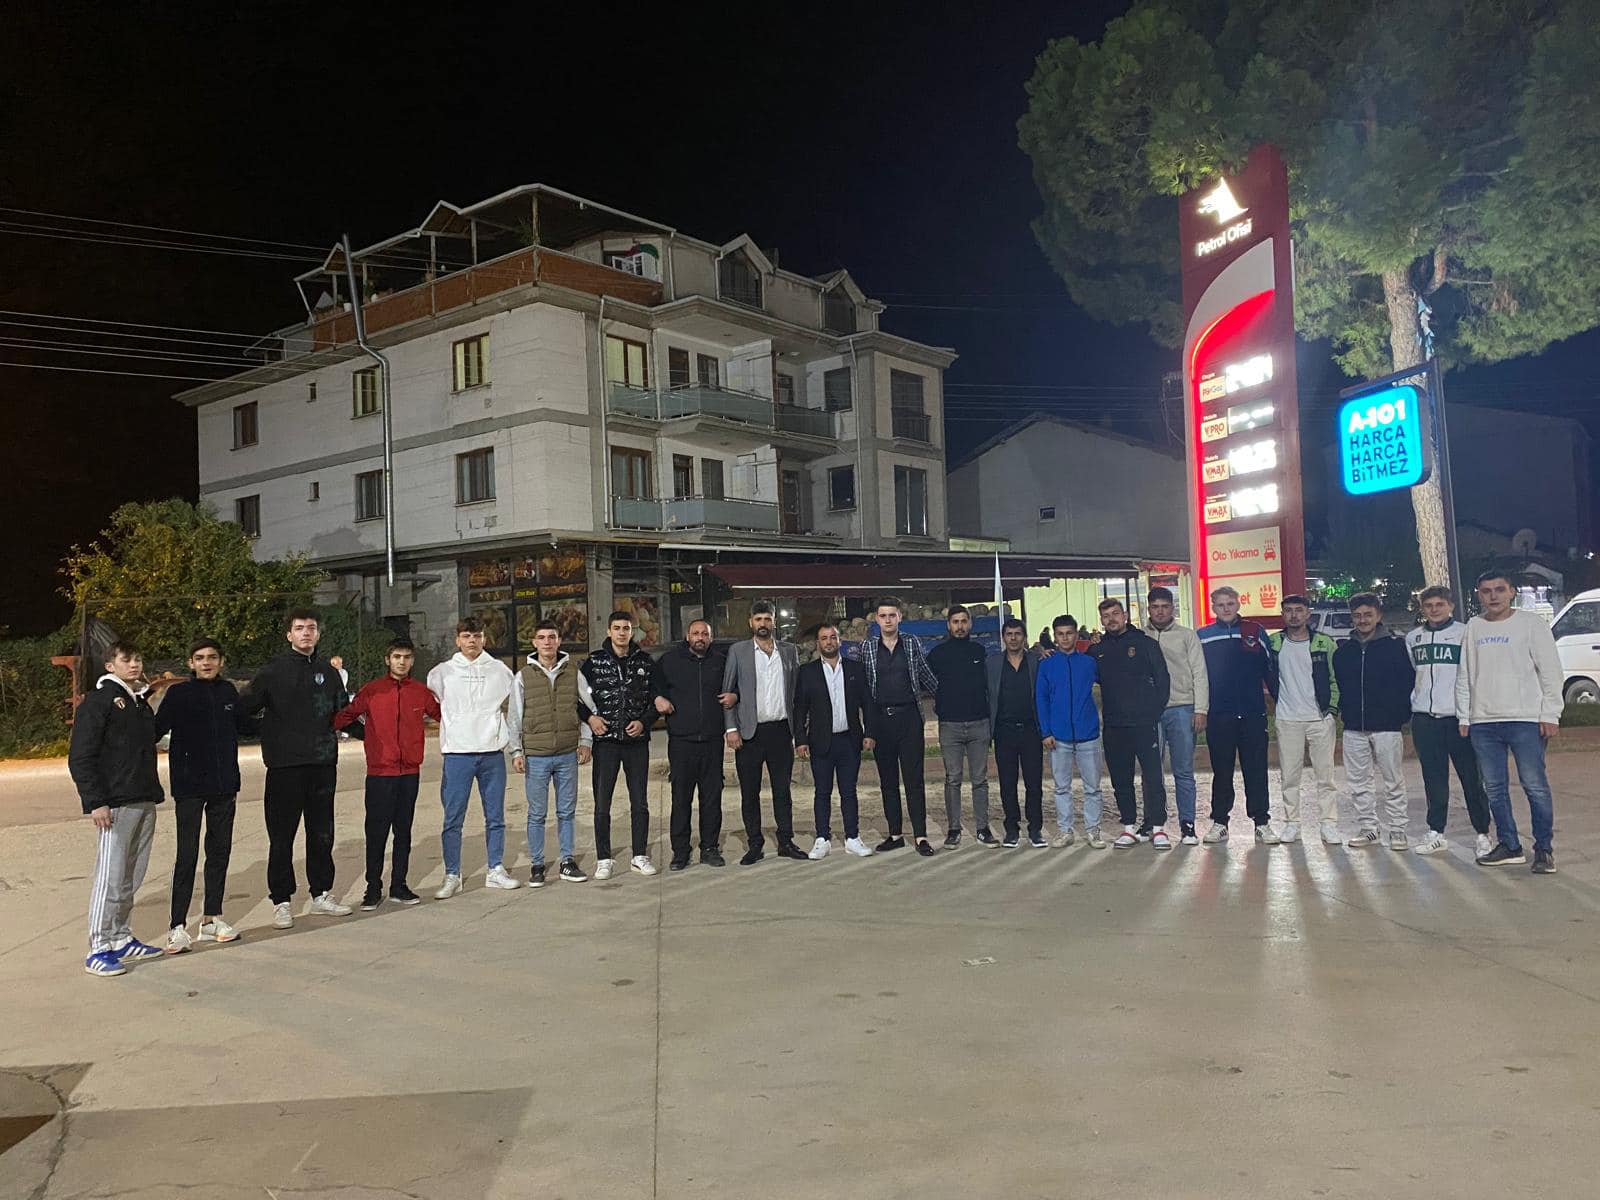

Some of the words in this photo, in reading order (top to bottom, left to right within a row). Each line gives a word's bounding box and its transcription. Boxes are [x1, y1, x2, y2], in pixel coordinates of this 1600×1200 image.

[1196, 231, 1227, 256] Petrol
[1350, 425, 1406, 451] HARCA
[1351, 442, 1408, 467] HARCA
[1212, 551, 1227, 561] Oto
[1477, 636, 1509, 646] OLYMPIA
